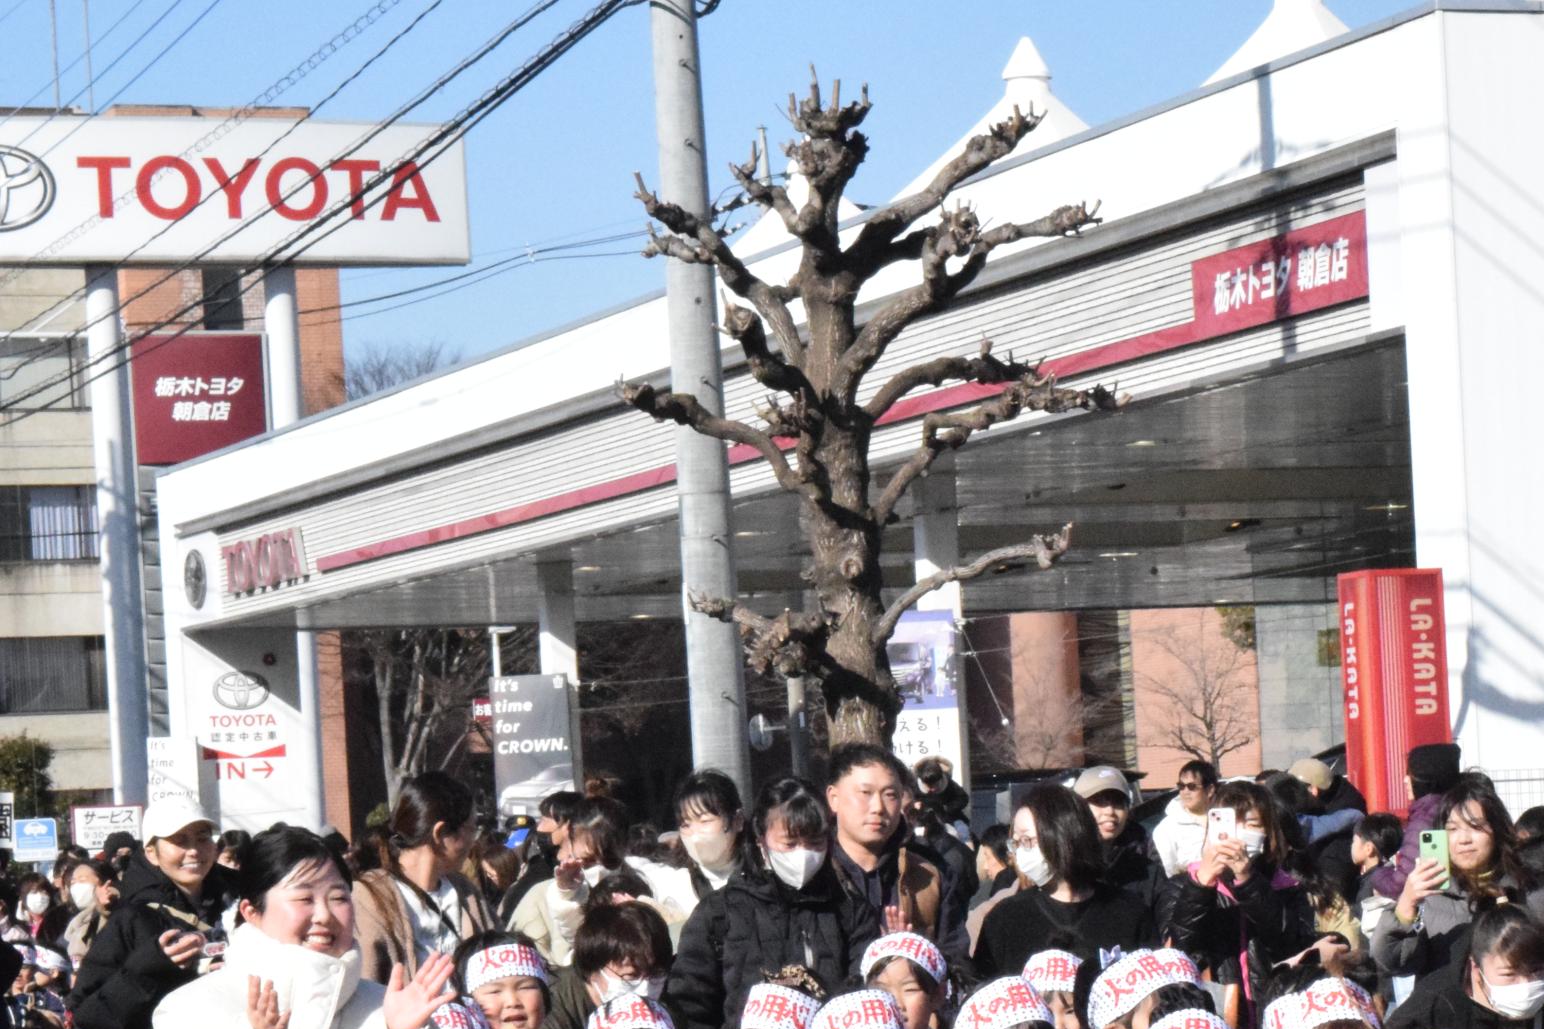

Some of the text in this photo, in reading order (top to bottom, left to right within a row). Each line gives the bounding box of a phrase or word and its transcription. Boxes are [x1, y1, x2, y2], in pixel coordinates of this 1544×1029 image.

[77, 155, 441, 222] TOYOTA
[1214, 237, 1349, 315] 栃木トヨタ 朝倉店
[155, 376, 244, 397] 栃木トヨタ
[172, 401, 231, 421] 朝倉店
[221, 528, 307, 593] TOYOTA
[494, 700, 533, 713] time
[209, 714, 276, 728] TOYOTA
[495, 720, 520, 734] for
[497, 737, 568, 754] CROWN.
[215, 762, 246, 780] IN
[84, 810, 134, 825] サービス
[480, 942, 547, 975] 火の用
[1104, 955, 1163, 1009] 火の用
